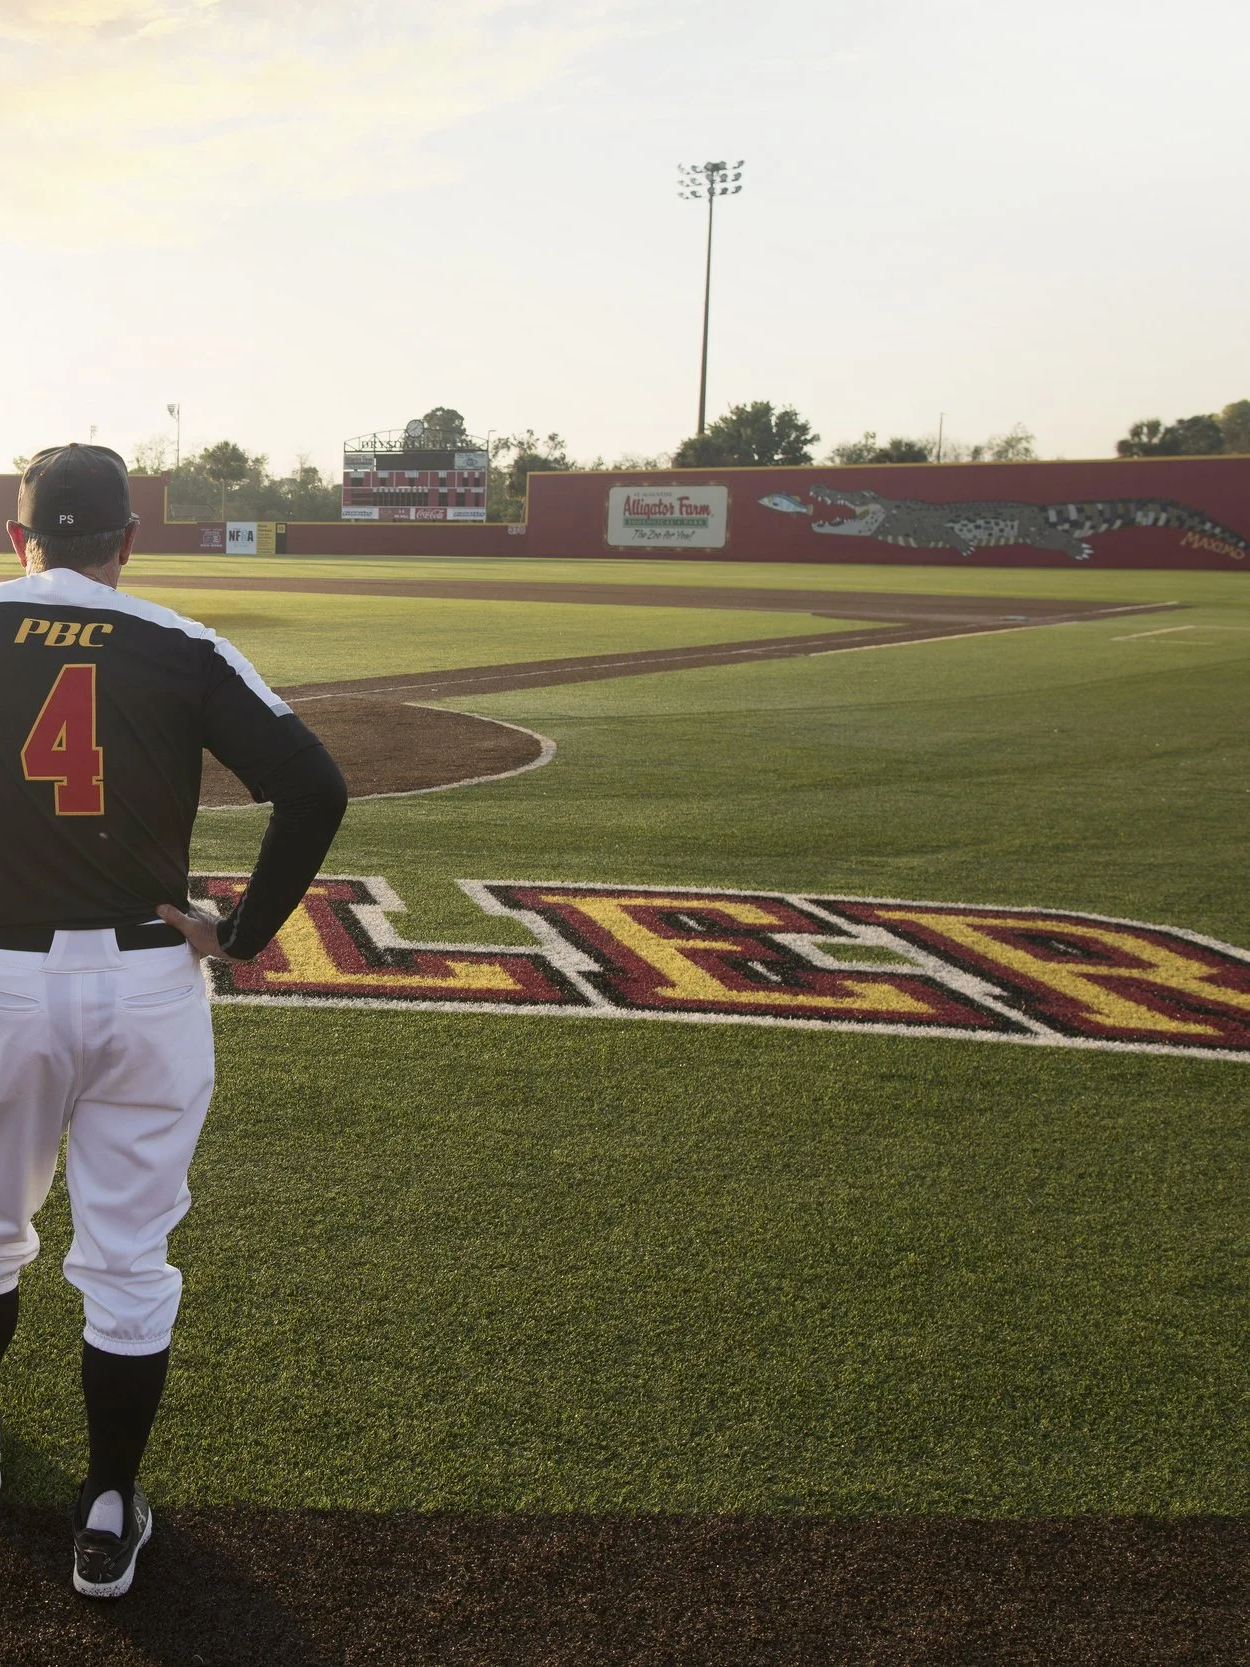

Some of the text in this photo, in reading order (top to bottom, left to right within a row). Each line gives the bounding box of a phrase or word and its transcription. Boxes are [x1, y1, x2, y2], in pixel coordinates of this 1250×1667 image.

[416, 509, 444, 520] Coca-Cola
[623, 495, 711, 519] Alligator Farm
[59, 514, 74, 525] PS
[632, 529, 647, 540] The
[647, 529, 662, 540] Zoo
[676, 530, 696, 541] You!
[1179, 531, 1246, 560] MAXIMO
[14, 617, 113, 648] PBC
[20, 663, 105, 816] 4
